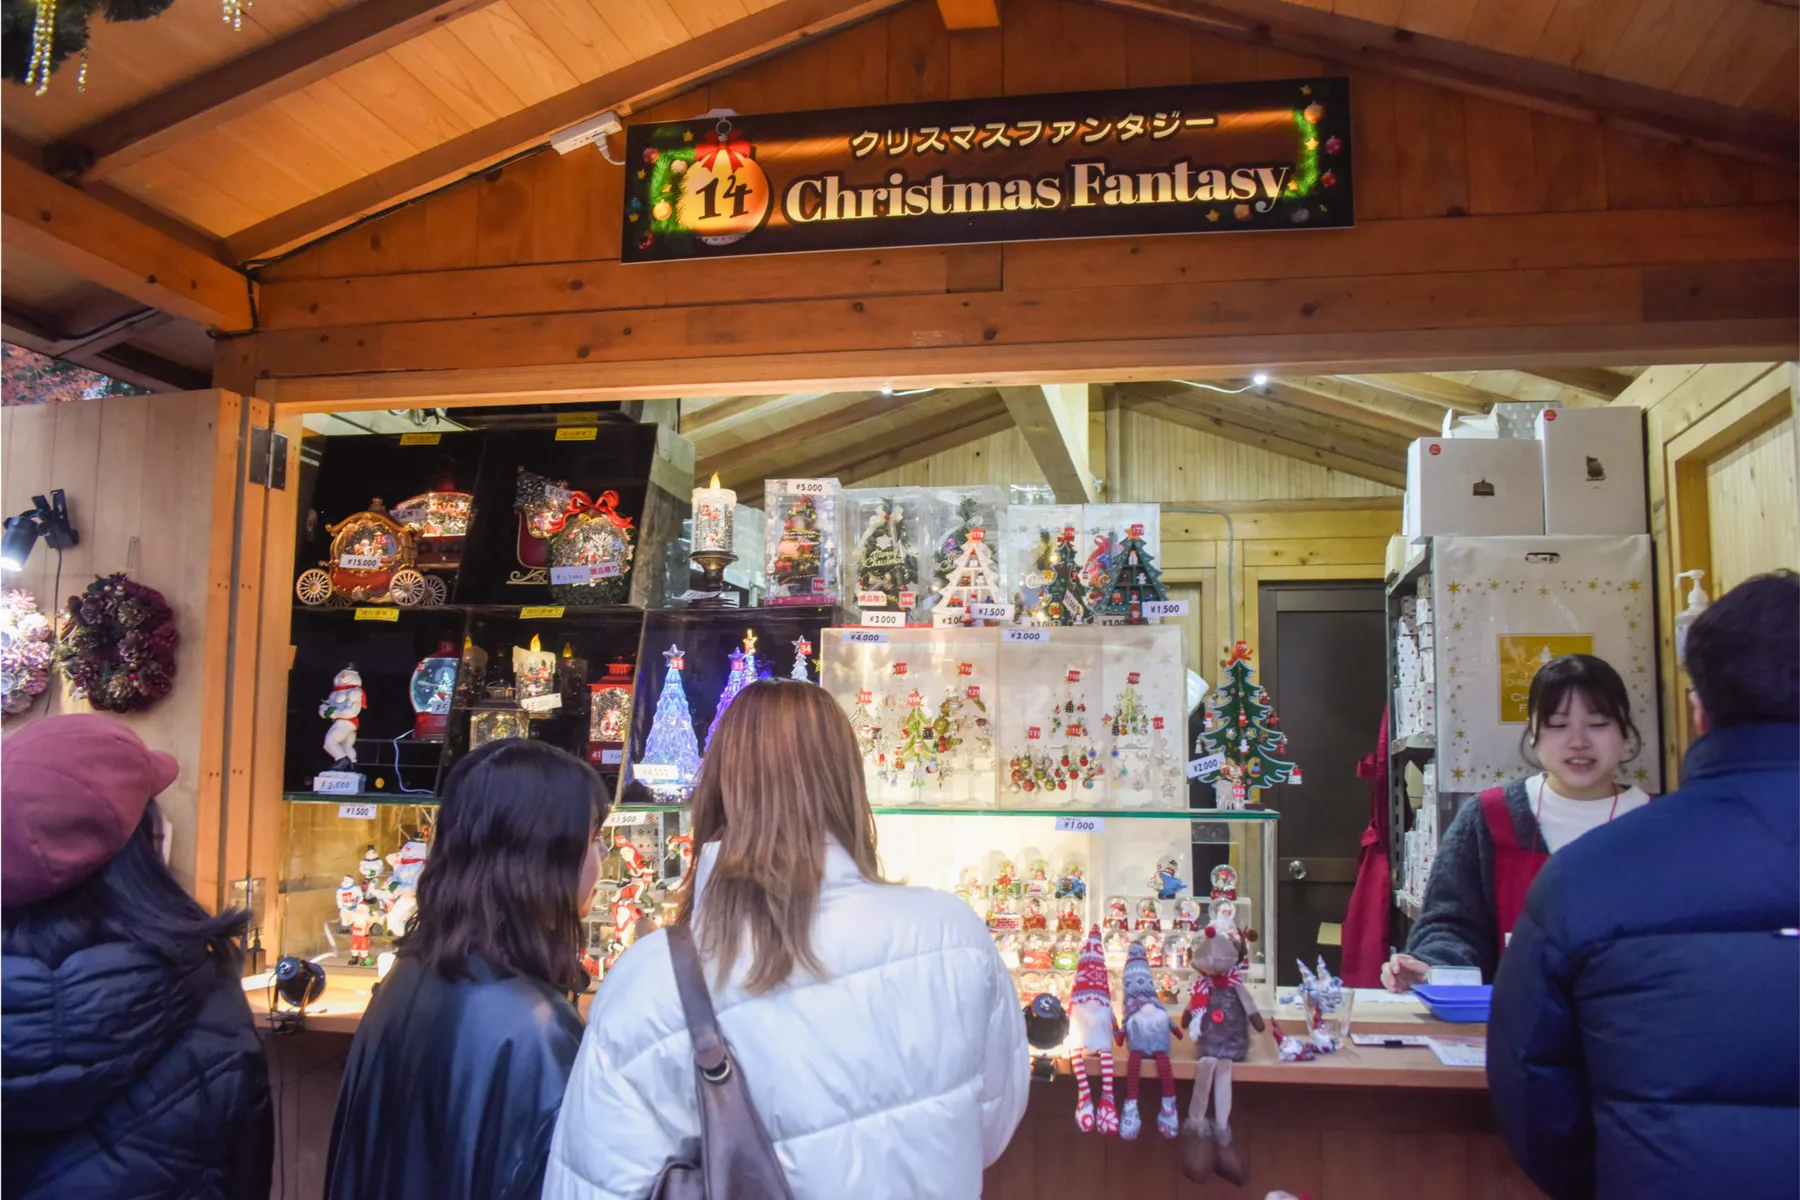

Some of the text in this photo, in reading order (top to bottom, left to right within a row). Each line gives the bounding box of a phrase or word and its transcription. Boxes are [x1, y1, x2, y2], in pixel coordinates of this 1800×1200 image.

[852, 110, 1215, 157] クリスマスファンタジー
[695, 174, 753, 220] 14
[786, 160, 1290, 223] Christmas Fantasy
[801, 644, 811, 653] 34
